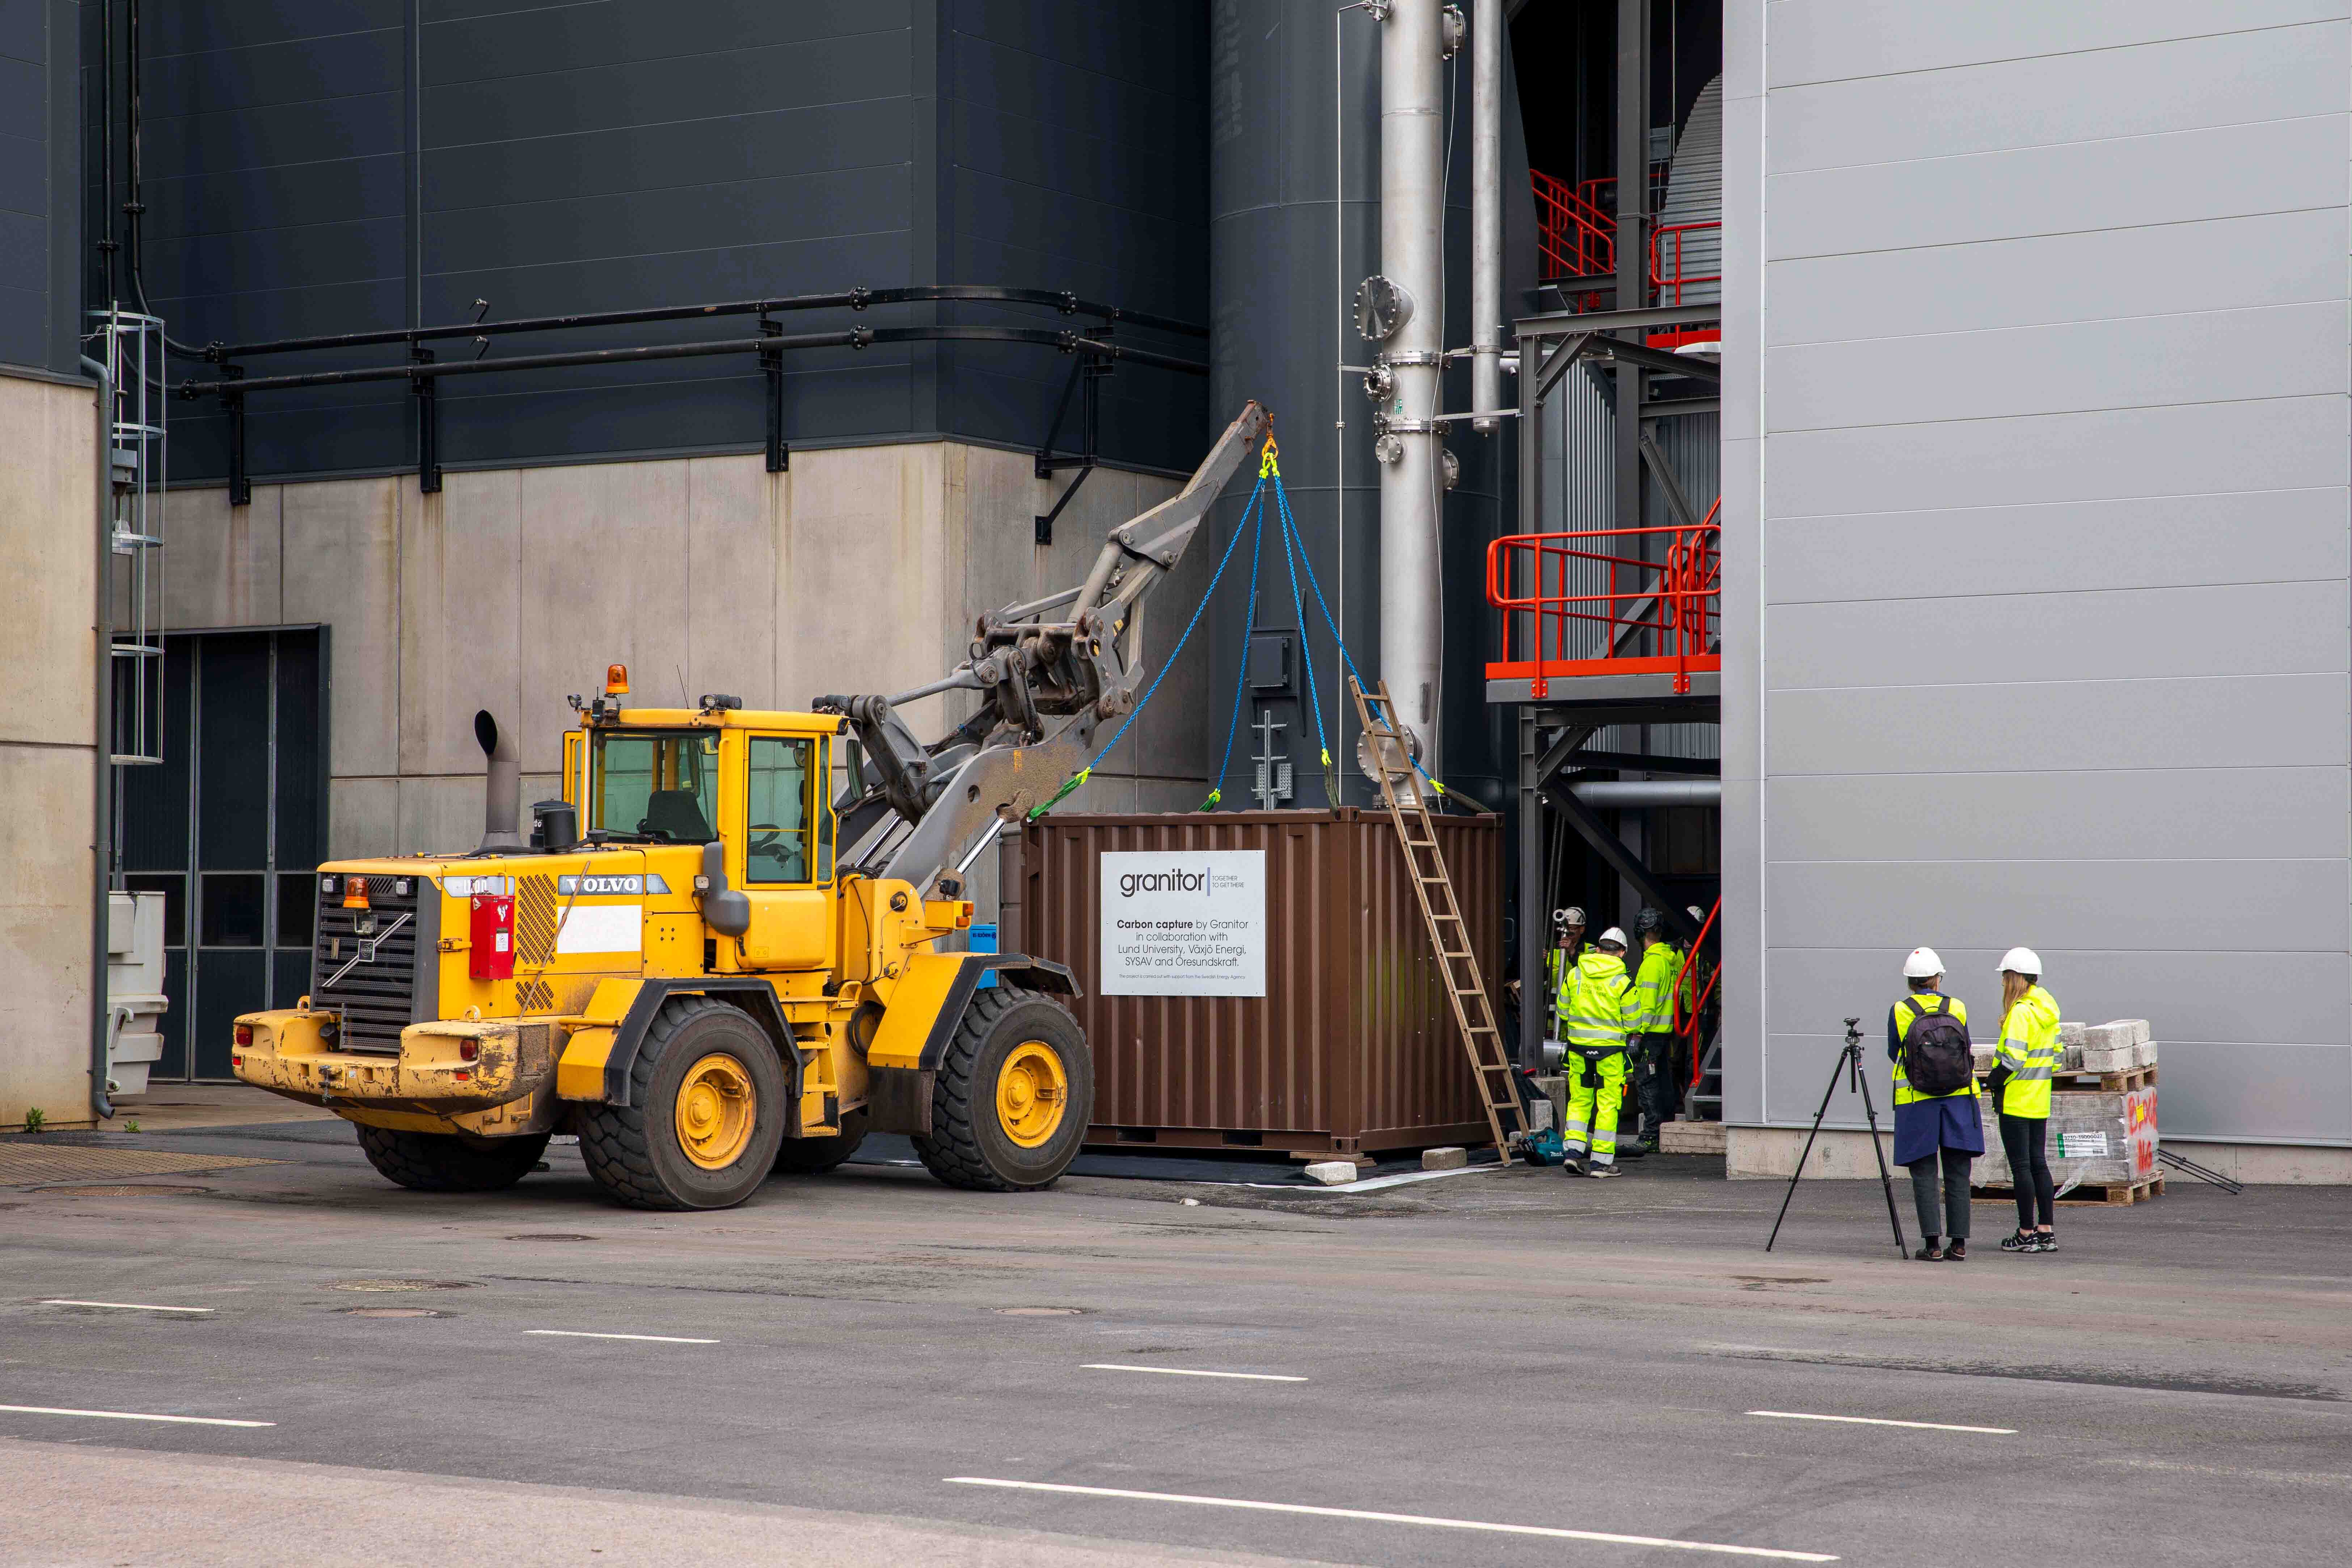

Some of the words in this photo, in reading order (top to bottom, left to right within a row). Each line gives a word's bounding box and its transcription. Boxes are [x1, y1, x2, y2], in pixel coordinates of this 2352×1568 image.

[567, 878, 637, 892] VOLVO
[1120, 868, 1204, 897] granitor
[1117, 920, 1152, 929] Carbon
[1156, 921, 1194, 930] capture
[1196, 920, 1207, 930] by
[1210, 920, 1248, 929] Granitor
[1136, 932, 1143, 941] in
[1147, 932, 1206, 941] collaboration
[1209, 932, 1228, 941] with
[1118, 944, 1140, 954] Lund
[1143, 944, 1185, 956] University,
[1188, 944, 1213, 956] Växjö
[1216, 944, 1246, 956] Energi,
[1126, 957, 1152, 966] SYSAV
[1155, 957, 1173, 966] and
[1176, 954, 1239, 967] Öresundskraft.
